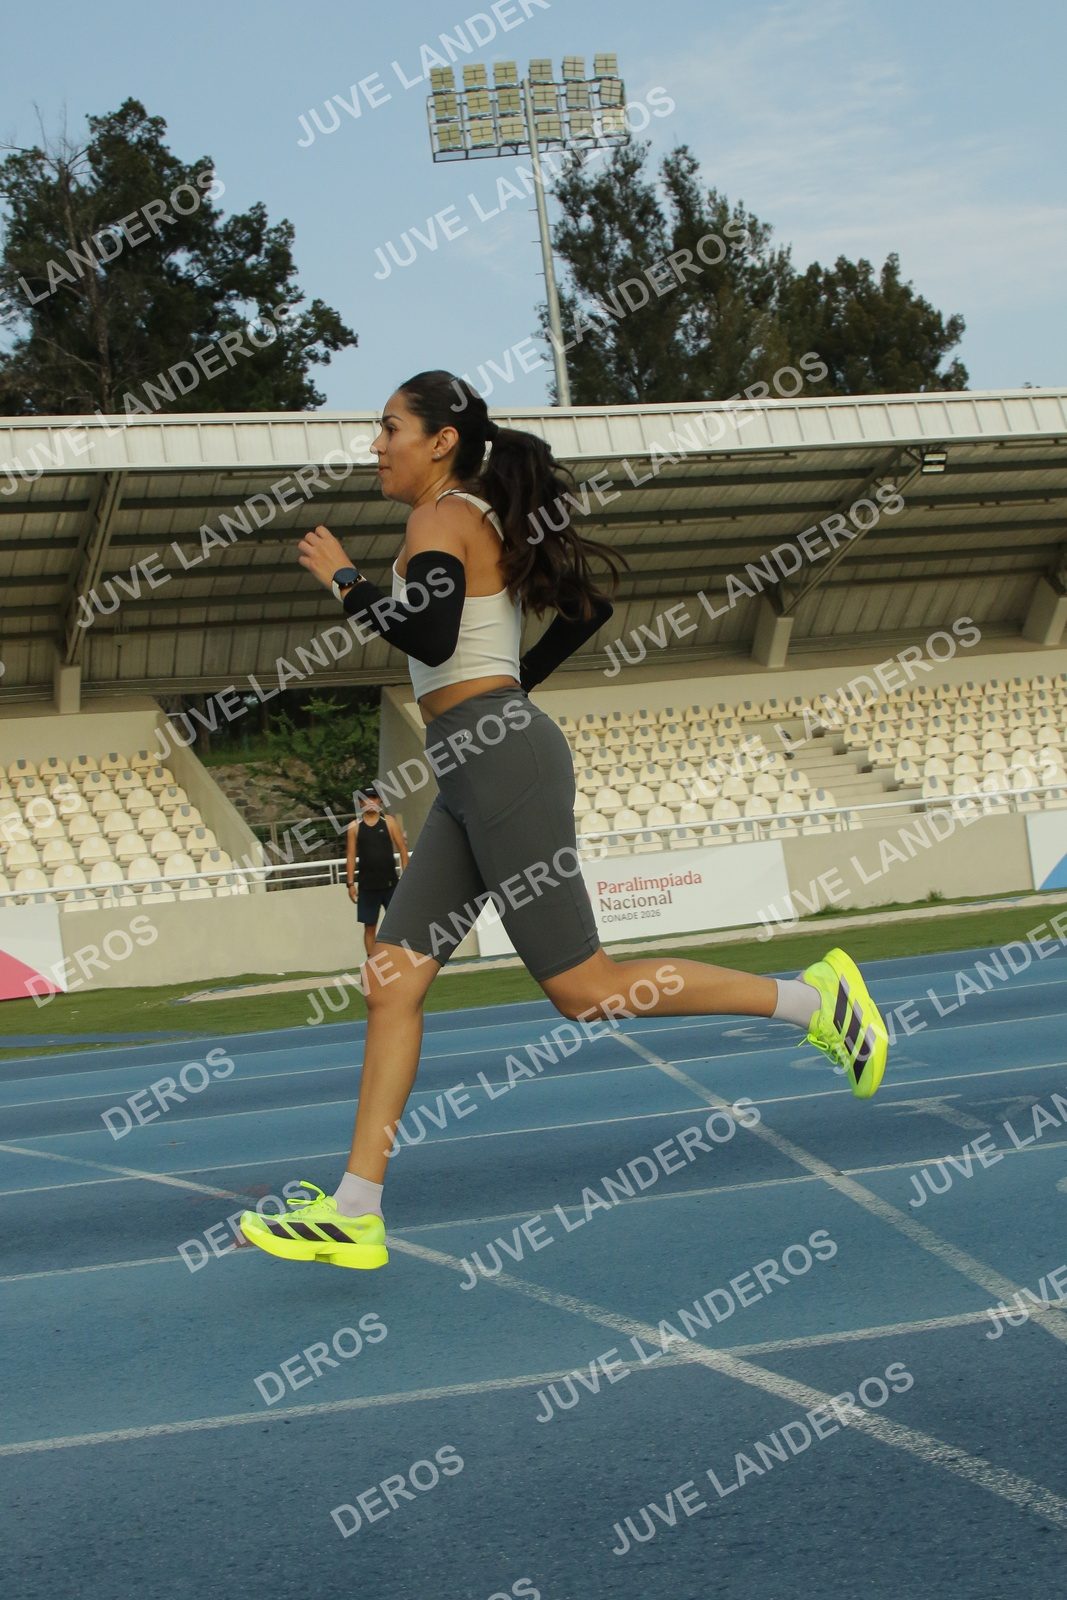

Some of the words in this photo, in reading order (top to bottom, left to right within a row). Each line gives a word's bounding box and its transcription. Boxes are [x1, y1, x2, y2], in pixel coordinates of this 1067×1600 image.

[599, 890, 673, 912] Nacional
[601, 911, 639, 923] CONADE
[641, 909, 661, 919] 2026
